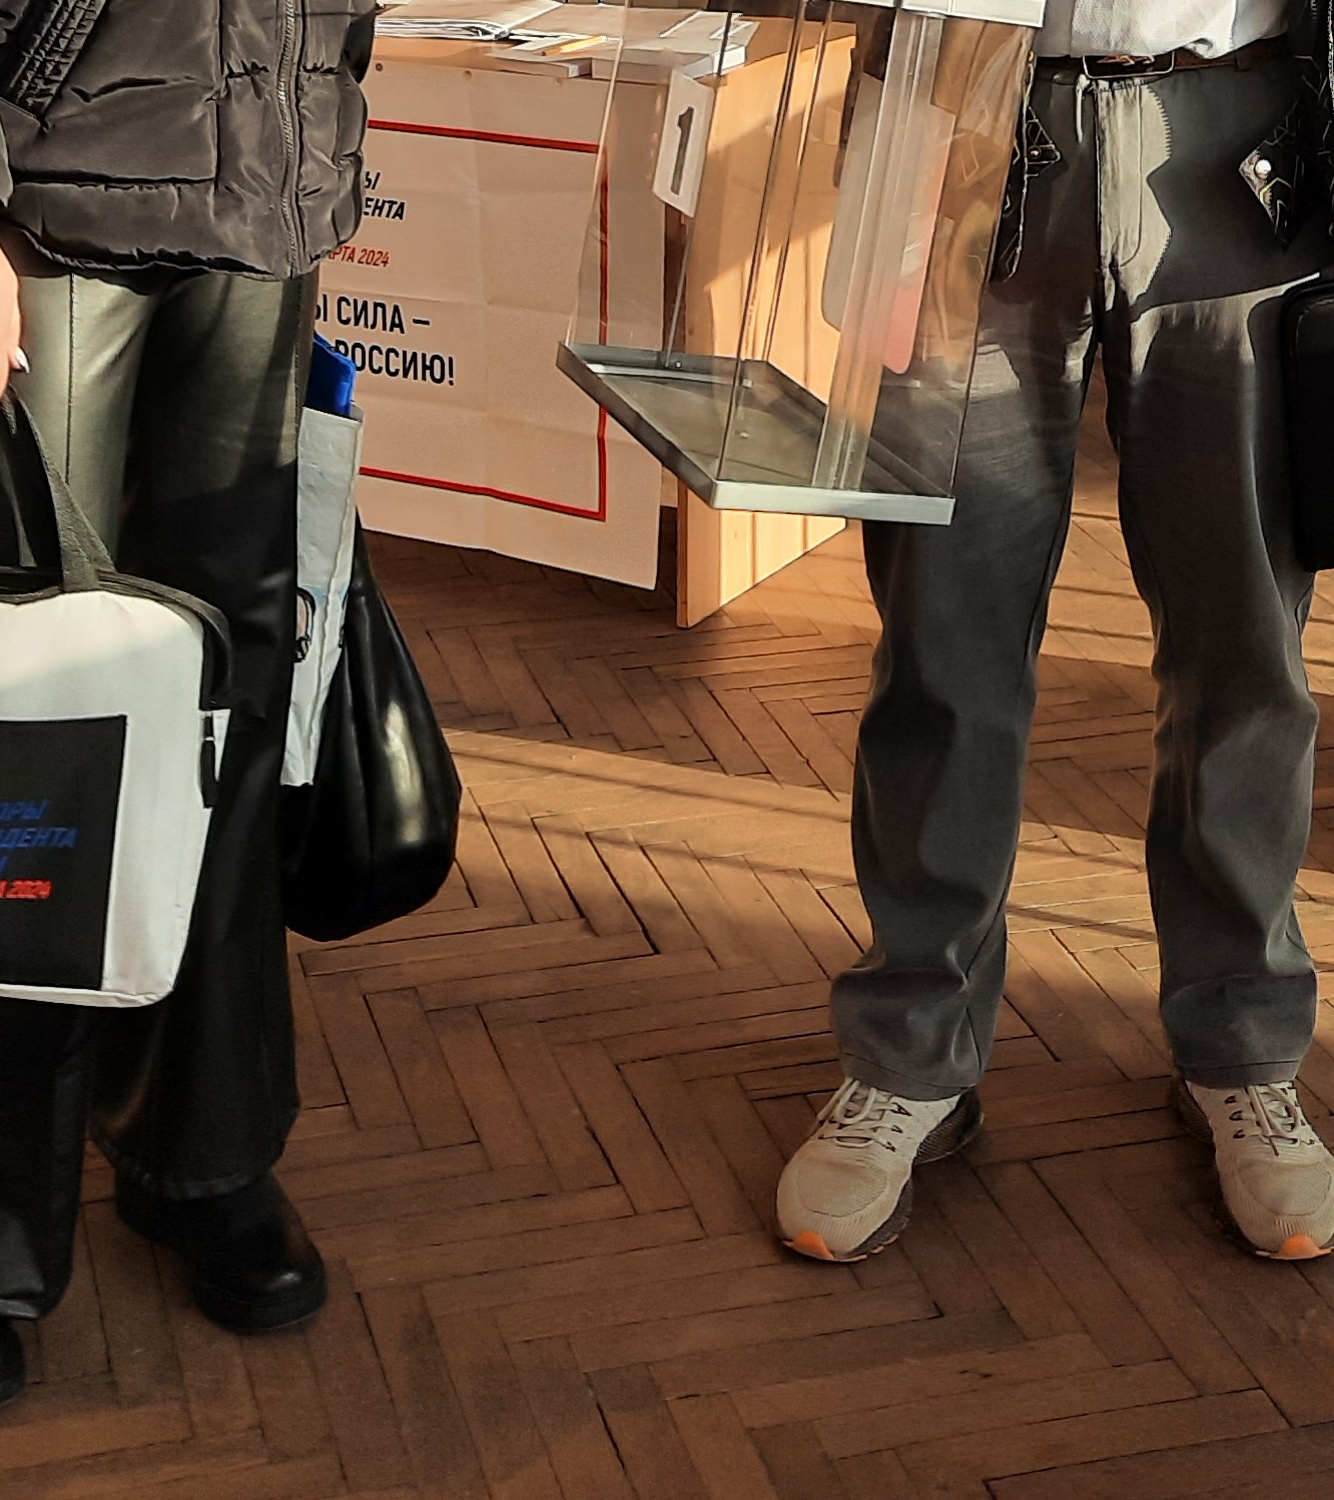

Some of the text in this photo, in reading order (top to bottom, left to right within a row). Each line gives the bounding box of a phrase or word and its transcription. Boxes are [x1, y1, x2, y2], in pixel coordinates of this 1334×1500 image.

[670, 105, 696, 197] 1
[328, 245, 390, 267] РТА 2024
[336, 296, 406, 334] СИЛА
